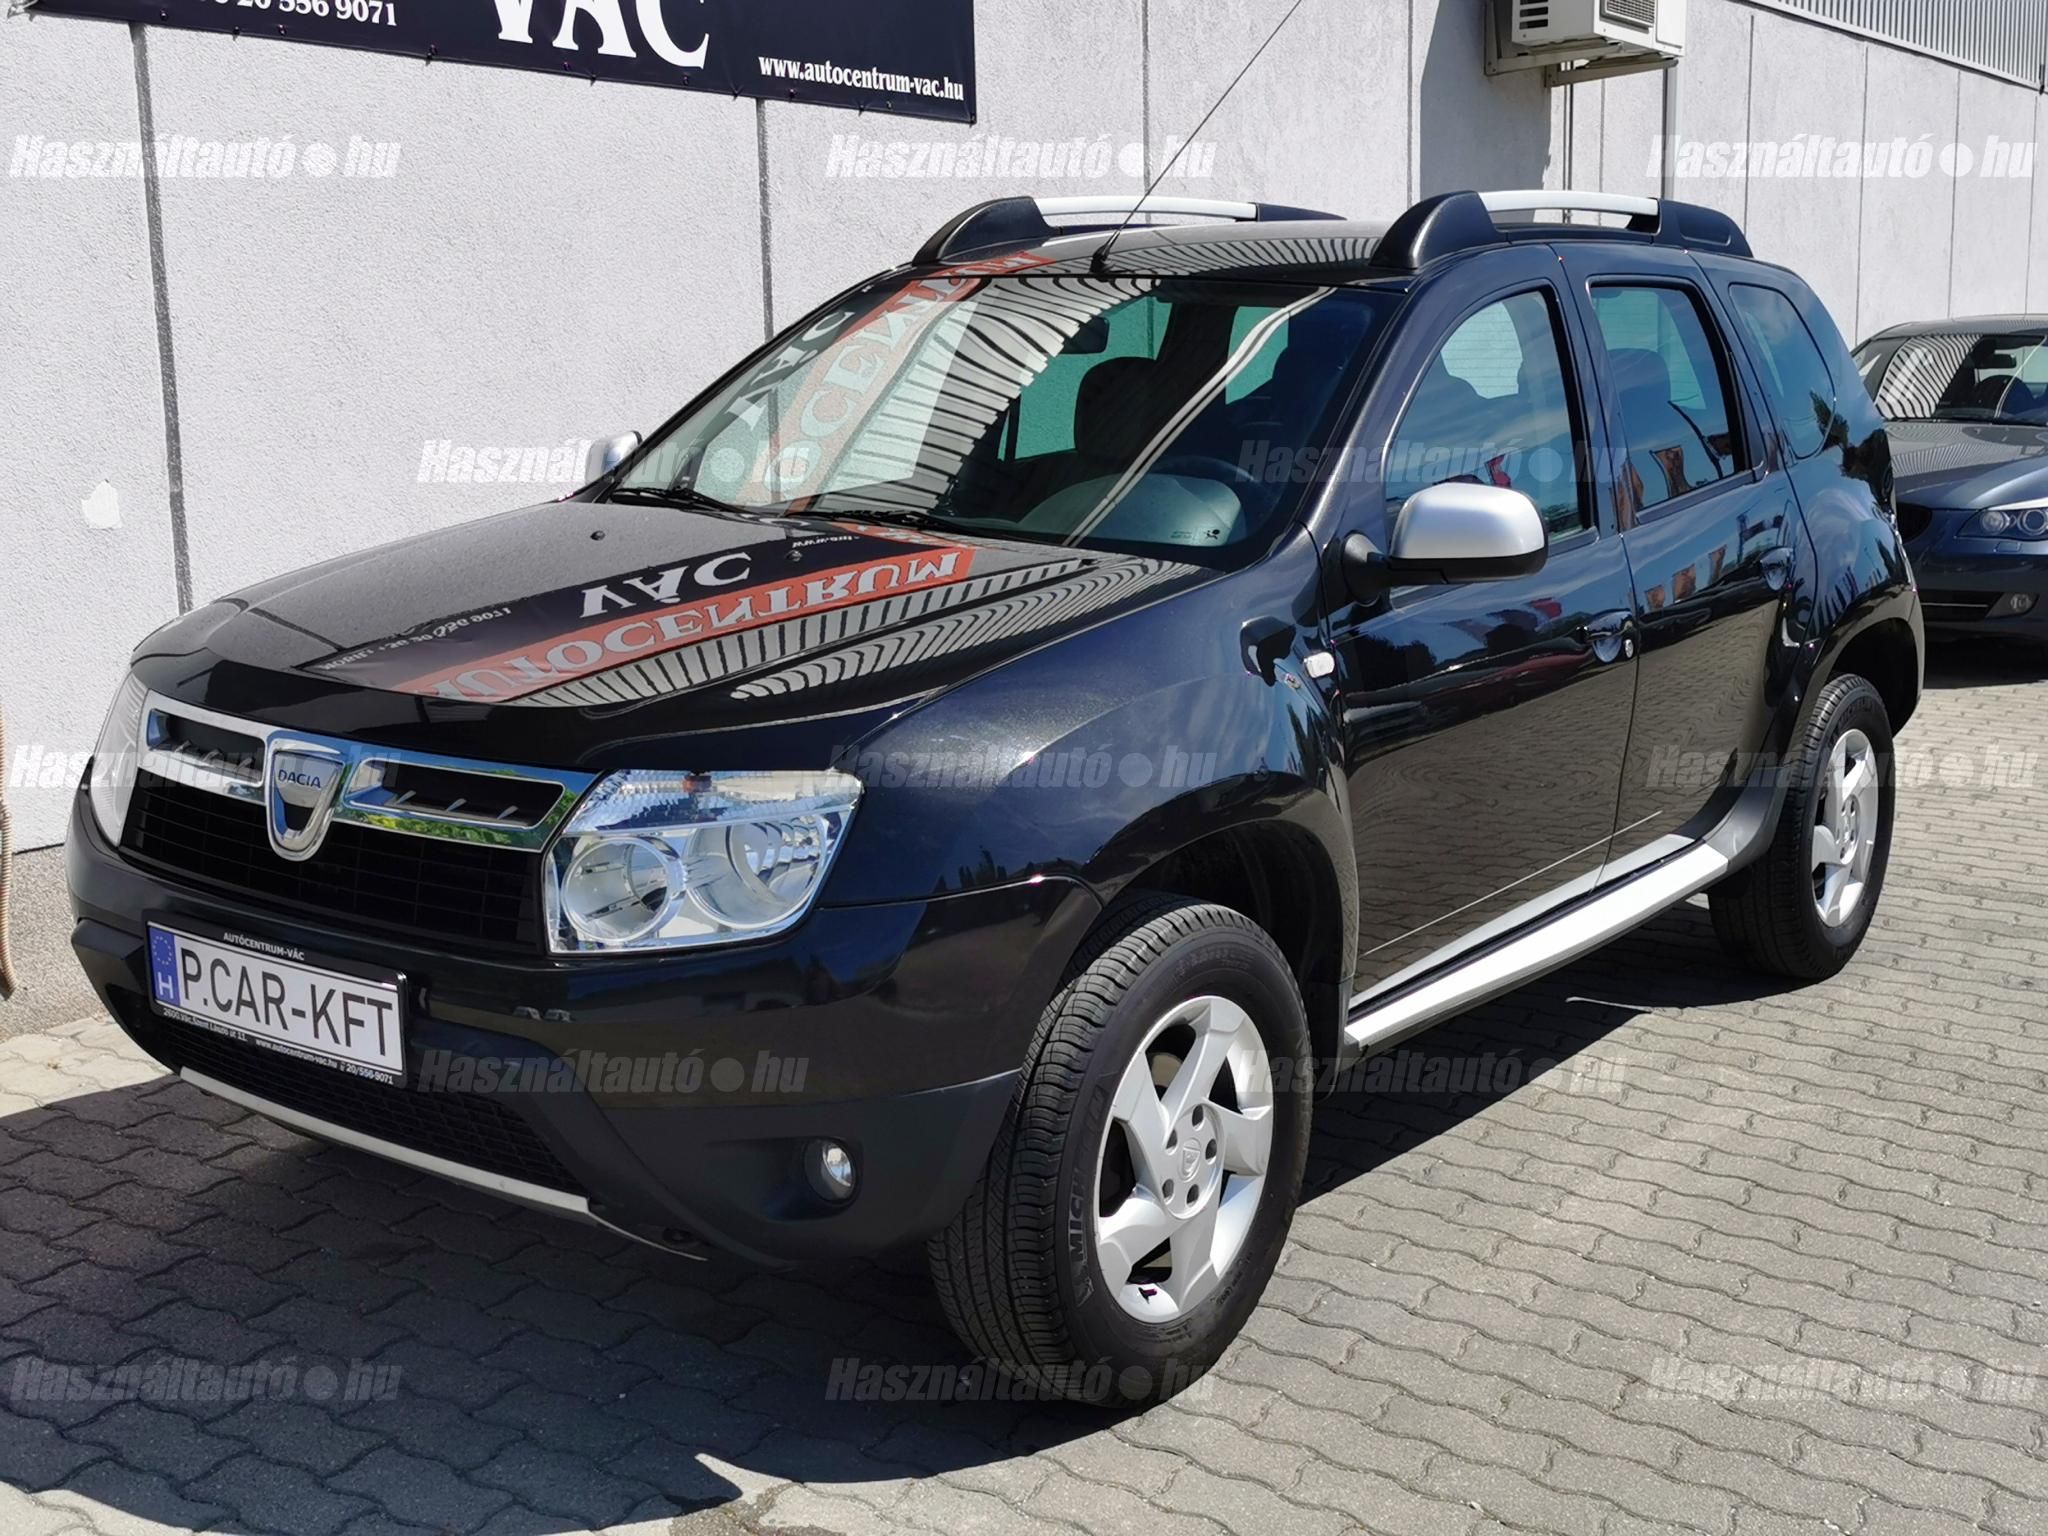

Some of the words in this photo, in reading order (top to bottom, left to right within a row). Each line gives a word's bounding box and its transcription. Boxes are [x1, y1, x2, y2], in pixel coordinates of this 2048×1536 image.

[336, 0, 397, 26] 9071
[758, 56, 964, 101] www.autocentrum-vac.hu
[277, 769, 321, 790] DACIA
[158, 971, 174, 1000] H
[180, 947, 394, 1058] P.CAR-KFT
